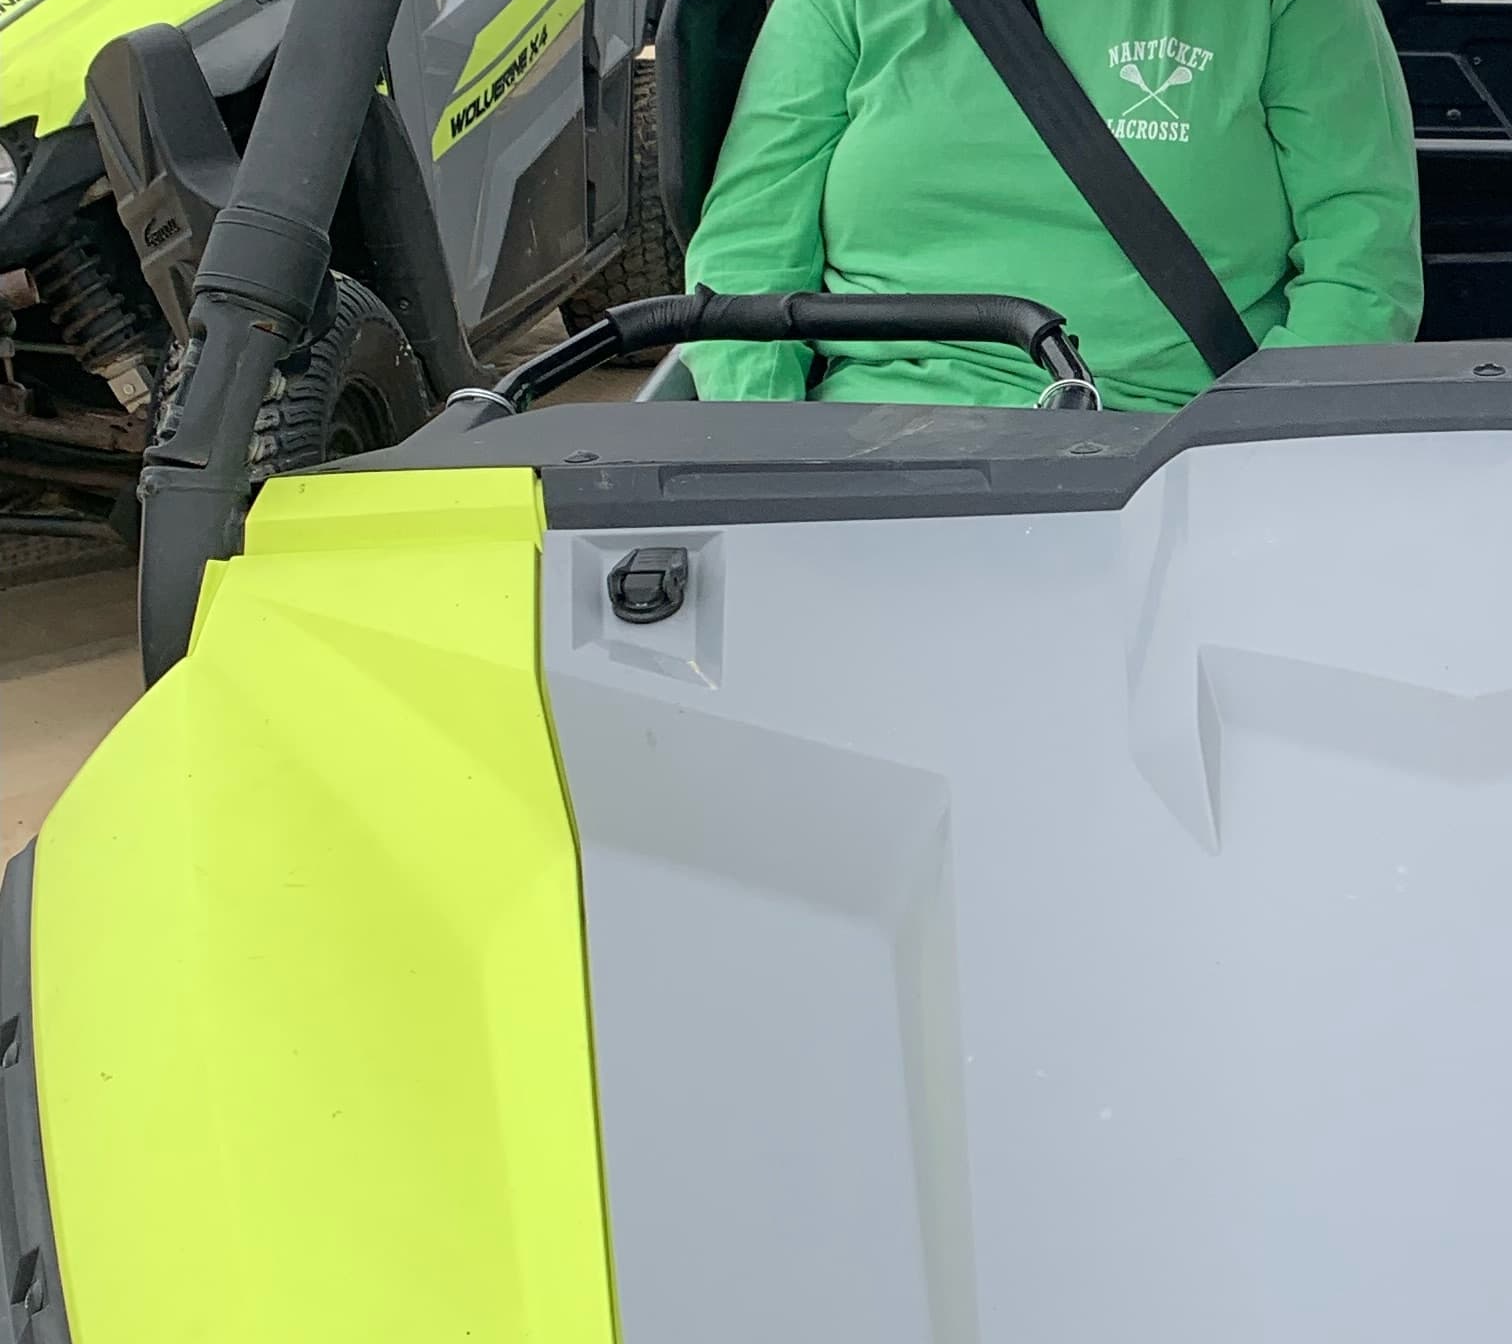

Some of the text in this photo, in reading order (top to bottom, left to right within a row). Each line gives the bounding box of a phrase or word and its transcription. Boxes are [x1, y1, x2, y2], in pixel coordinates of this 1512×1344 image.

[1107, 35, 1214, 72] NANTUCKET
[450, 23, 549, 138] WOLVERINE X4
[1105, 118, 1190, 142] LACROSSE
